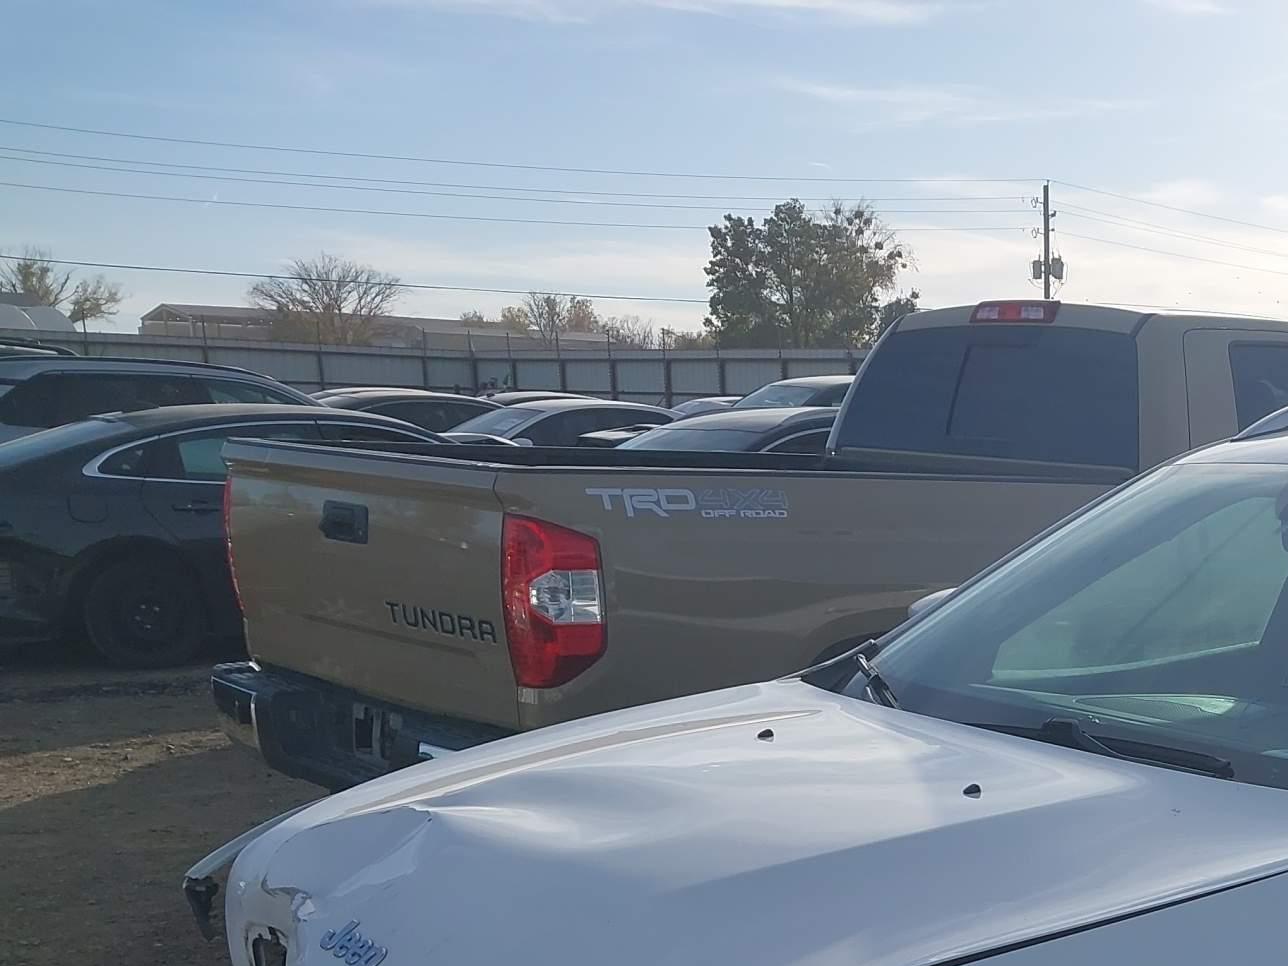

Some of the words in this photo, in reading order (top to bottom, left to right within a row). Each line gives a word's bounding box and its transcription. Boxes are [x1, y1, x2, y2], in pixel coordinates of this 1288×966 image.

[585, 488, 696, 518] TRD
[701, 509, 737, 519] OFF
[740, 509, 788, 519] ROAD
[385, 600, 498, 644] TUNDRA
